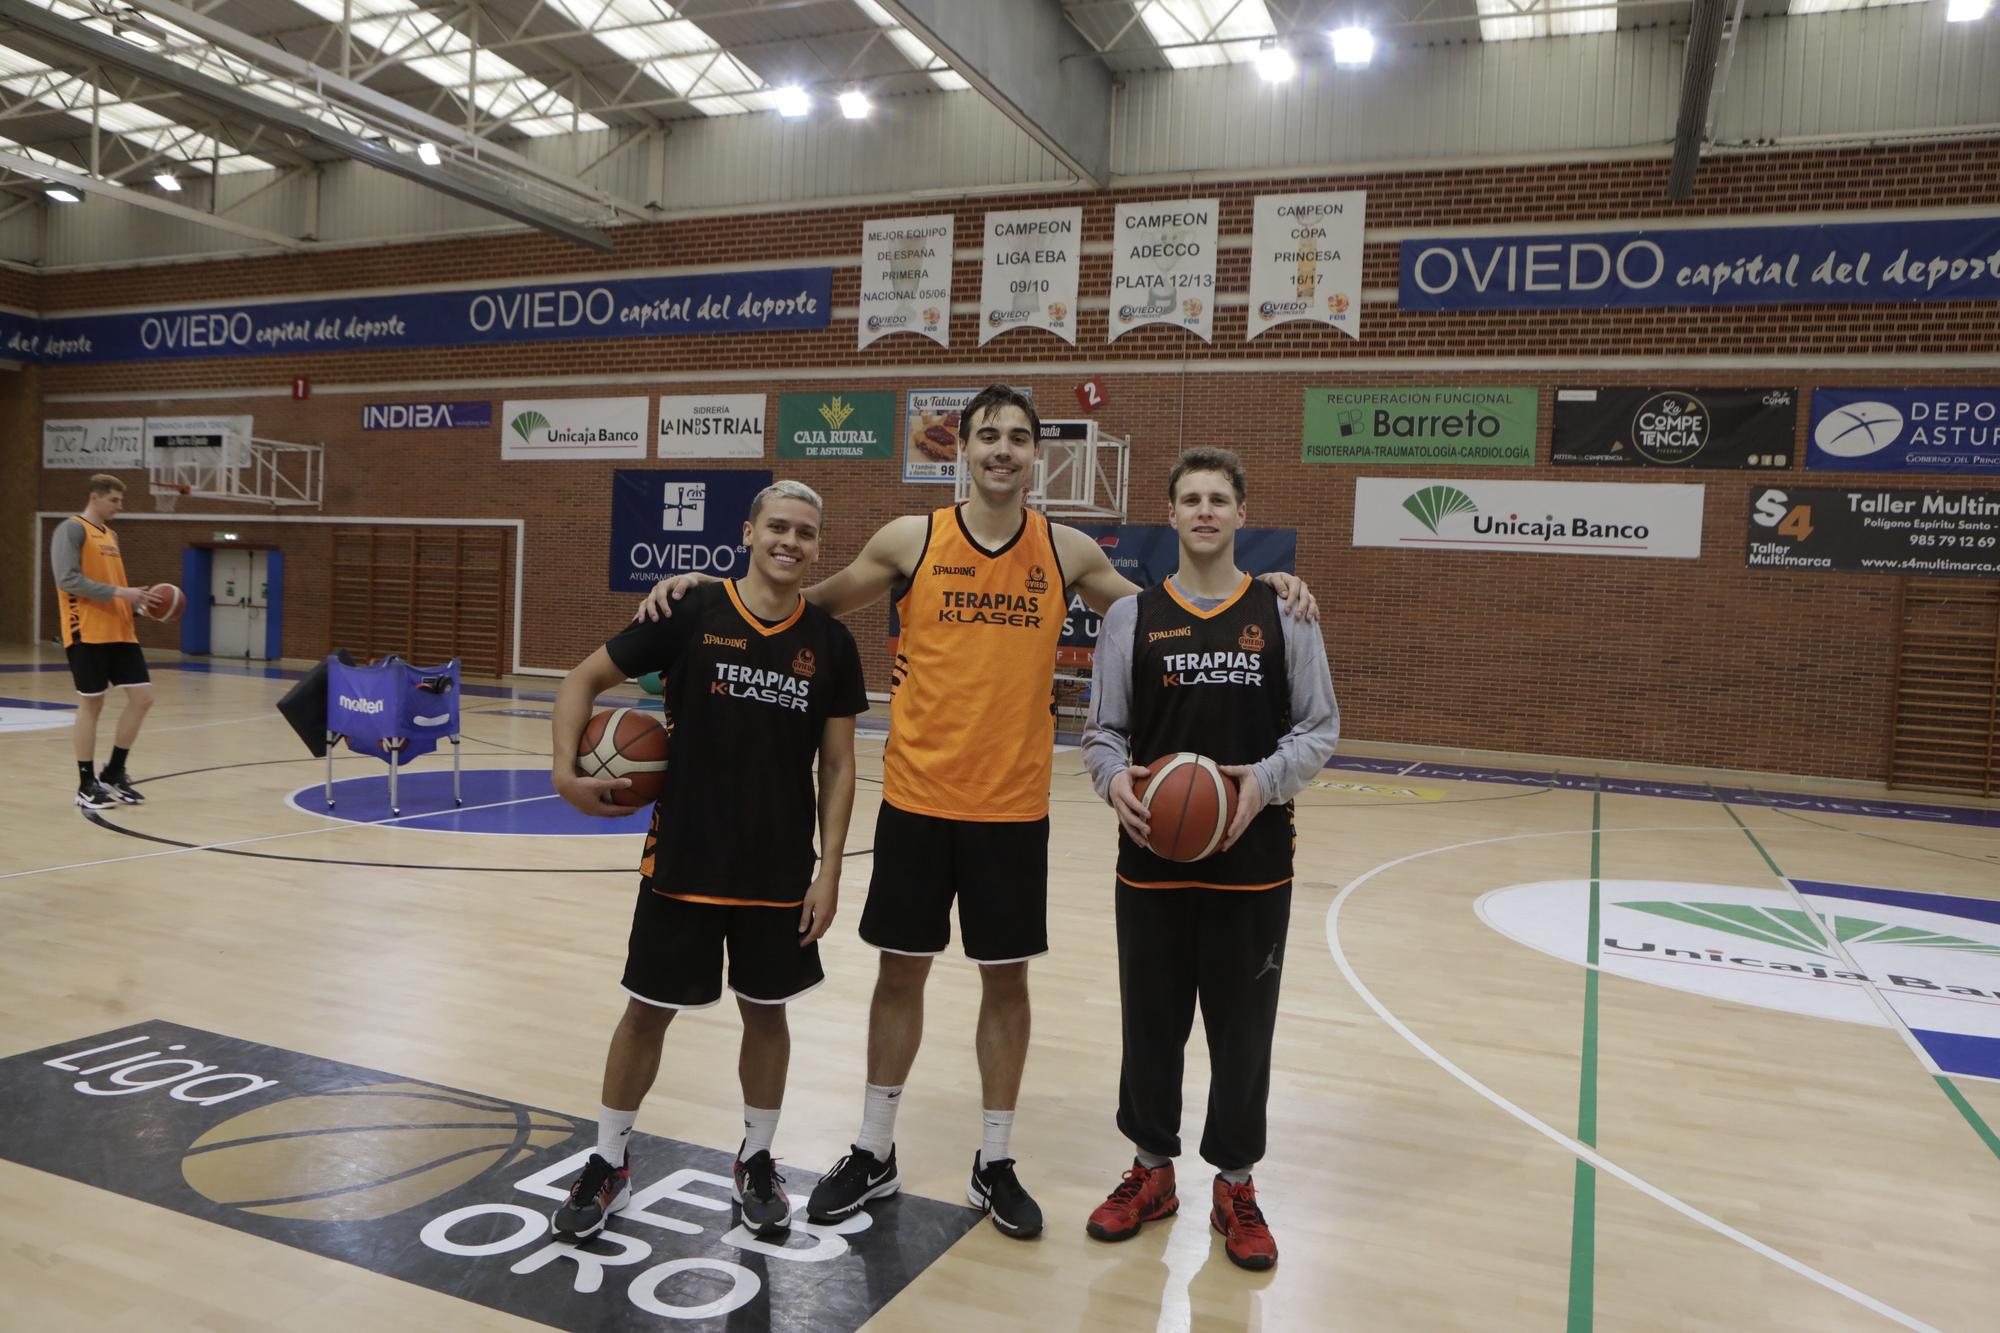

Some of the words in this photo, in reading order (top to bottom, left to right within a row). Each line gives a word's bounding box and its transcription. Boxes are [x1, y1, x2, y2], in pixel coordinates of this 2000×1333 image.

[1276, 204, 1344, 217] CAMPEON
[994, 220, 1072, 237] CAMPEON
[1125, 212, 1209, 229] CAMPEON
[867, 230, 904, 242] MEJOR
[906, 227, 947, 240] EQUIPO
[1290, 228, 1327, 239] COPA
[877, 251, 893, 261] DE
[894, 247, 935, 260] ESPAÑA
[996, 251, 1031, 266] LIGA
[1034, 250, 1067, 264] EBA
[1129, 243, 1201, 259] ADECCO
[1274, 250, 1342, 263] PRINCESA
[882, 269, 929, 280] PRIMERA
[1414, 240, 1665, 295] OVIEDO
[1675, 254, 1800, 295] capital
[1811, 251, 1871, 287] del
[1009, 280, 1050, 293] 09/10
[1115, 275, 1165, 289] PLATA
[1169, 274, 1213, 288] 12/13
[1289, 274, 1324, 286] 16/17
[863, 291, 917, 301] NACIONAL
[919, 289, 947, 299] 05/06
[469, 287, 615, 332] OVIEDO
[619, 296, 692, 329] capital
[698, 294, 731, 321] del
[737, 290, 818, 325] deporte
[140, 312, 253, 350] OVIEDO
[256, 319, 310, 348] capital
[314, 317, 341, 341] del
[344, 314, 407, 343] deporte
[296, 379, 305, 398] 1
[1083, 382, 1102, 406] 2
[913, 396, 928, 409] Las
[930, 395, 961, 407] Tablas
[1435, 393, 1512, 404] FUNCIONAL
[363, 404, 453, 429] INDIBA
[693, 405, 730, 415] SIDRERÍA
[1911, 402, 1996, 421] DEPO
[1373, 409, 1501, 438] Barreto
[547, 428, 597, 446] Unicaja
[599, 429, 639, 442] Banco
[794, 431, 826, 445] CAJA
[829, 430, 878, 445] RURAL
[1639, 430, 1700, 448] TENCIA
[820, 446, 864, 456] ASTURIAS
[1847, 493, 1917, 514] Taller
[1753, 489, 1815, 543] S4
[1864, 517, 1912, 531] Polígono
[1913, 518, 1955, 531] Espíritu
[1958, 520, 1991, 531] Santo
[1473, 514, 1567, 541] Unicaja
[1571, 518, 1650, 540] Banco
[1750, 542, 1791, 555] Taller
[1909, 534, 1935, 546] 985
[1938, 535, 1956, 547] 79
[1959, 536, 1974, 547] 12
[1977, 536, 1996, 548] 69
[1749, 553, 1832, 568] Multimarca
[932, 565, 976, 577] SPALDING
[1024, 580, 1049, 590] OVIEDO
[942, 591, 1039, 614] TERAPIAS
[703, 633, 748, 650] SPALDING
[1148, 626, 1192, 643] SPALDING
[1163, 651, 1261, 672] TERAPIAS
[715, 662, 810, 697] TERAPIAS
[339, 694, 384, 714] molten
[1604, 938, 1876, 983] Unicaja
[1887, 974, 2000, 999] Ba
[43, 1036, 279, 1106] Liga
[420, 1204, 761, 1320] ORO
